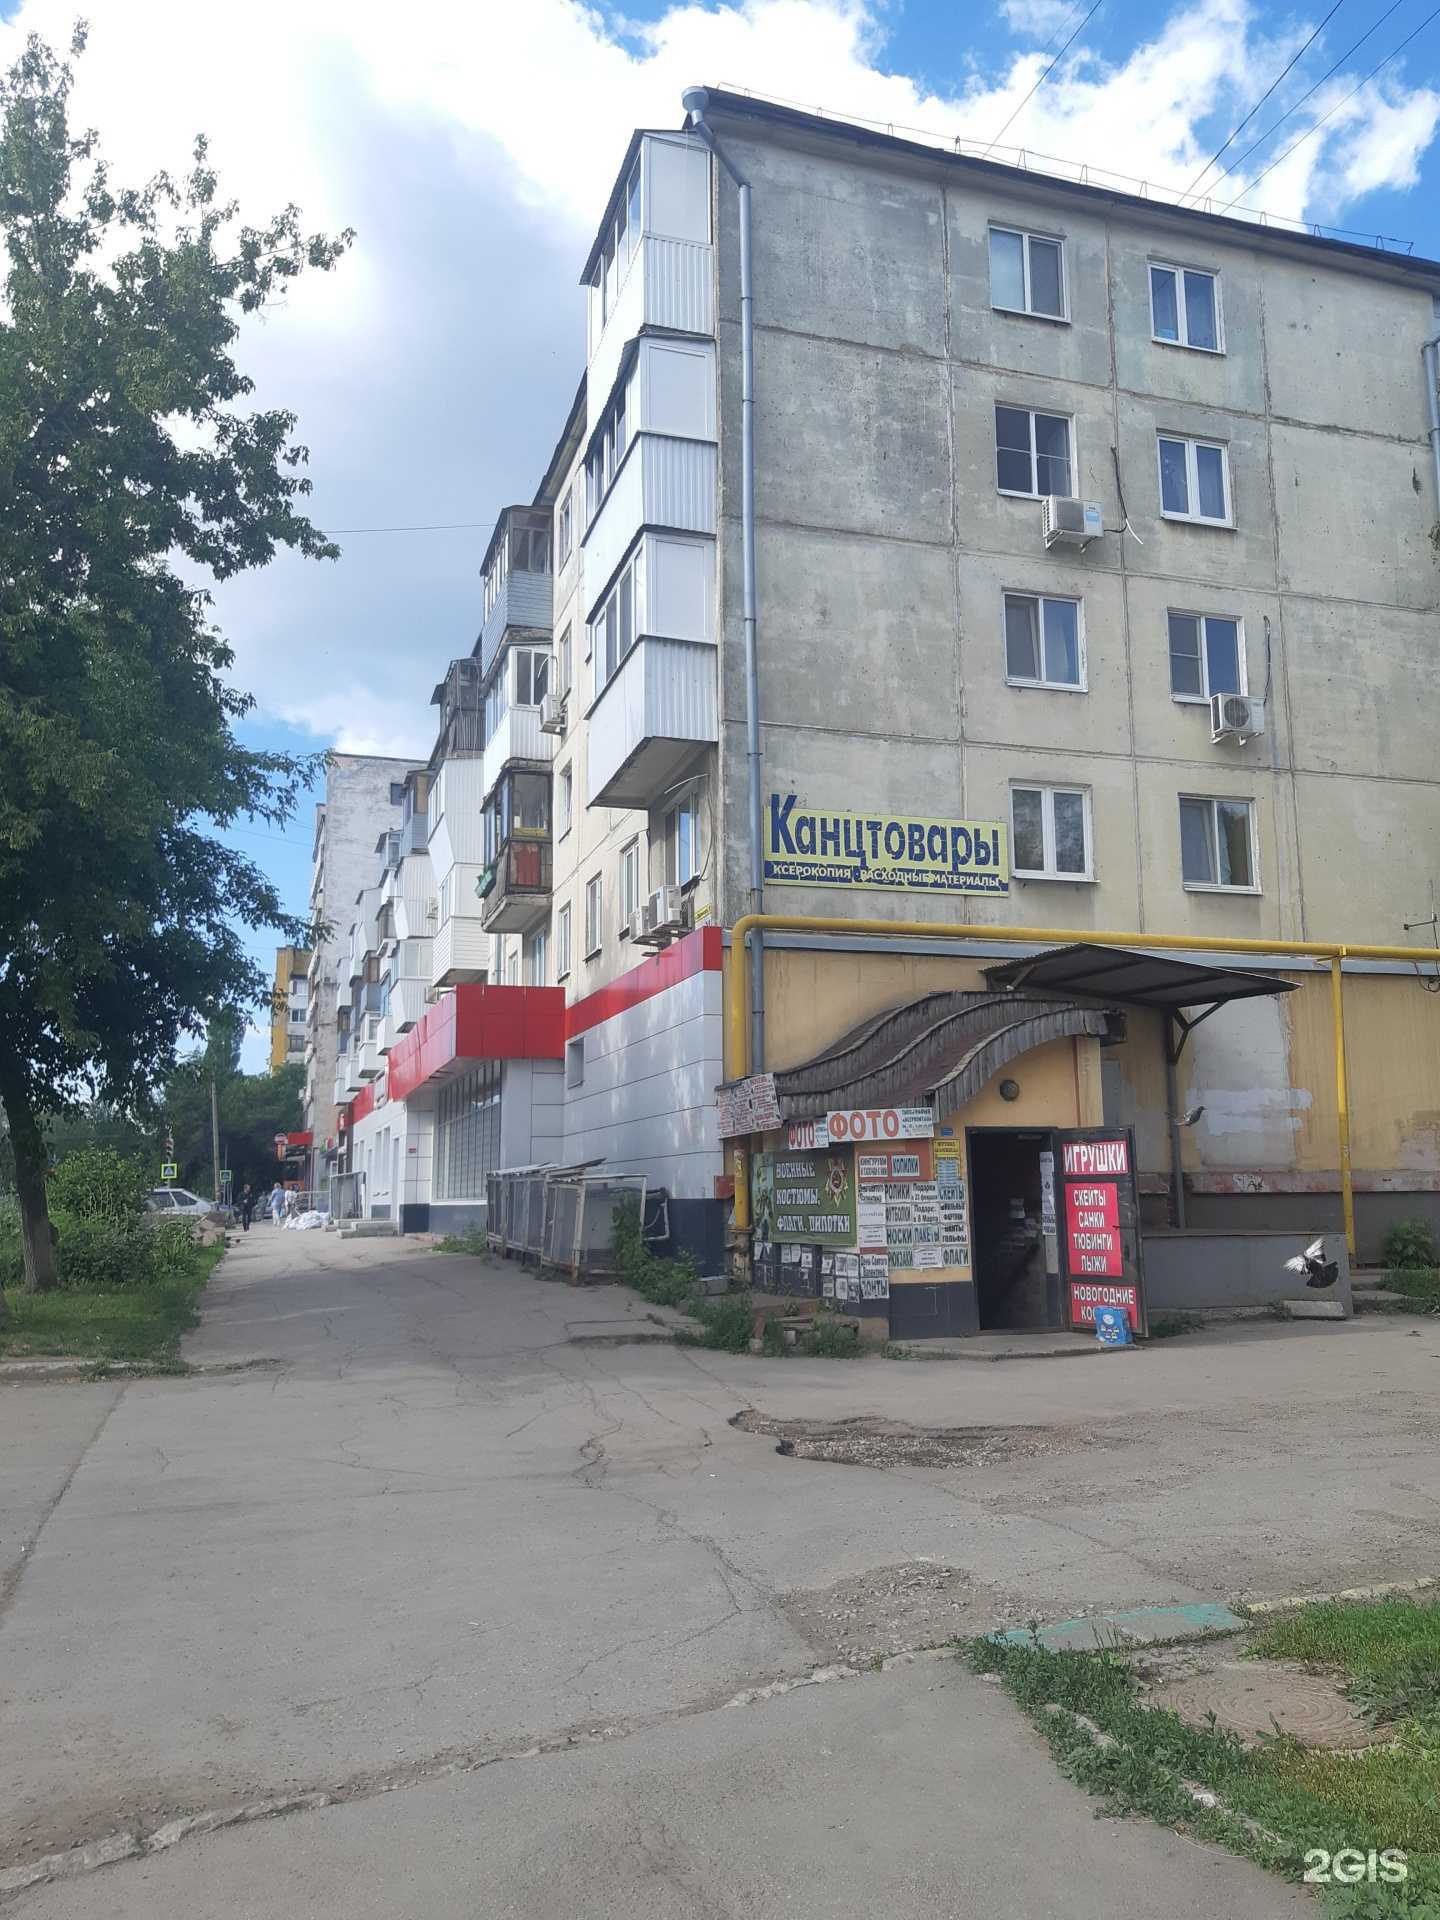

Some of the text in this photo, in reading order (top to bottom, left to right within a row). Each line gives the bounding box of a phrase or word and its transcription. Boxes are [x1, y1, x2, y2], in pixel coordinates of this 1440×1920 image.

[770, 793, 1000, 873] Канцтовары
[773, 863, 851, 879] КСЕРОКОПИЯ
[860, 867, 928, 885] РАСХОДНЫЕ
[789, 1120, 815, 1148] ФОТО
[829, 1110, 899, 1140] ФОТО
[1064, 1143, 1126, 1173] ИГРУШКИ
[776, 1162, 816, 1178] ВОЕННЫЕ
[884, 1183, 910, 1201] РОЛИКИ
[808, 1215, 850, 1233] ПИЛОТКИ
[1078, 1211, 1105, 1228] САНКИ
[886, 1227, 912, 1245] НОСКИ
[1073, 1233, 1113, 1251] ТЮБИНГИ
[943, 1248, 969, 1265] ФЛАГИ
[1081, 1255, 1107, 1272] ЛЫЖИ
[1073, 1285, 1135, 1305] НОВОГОДНИЕ
